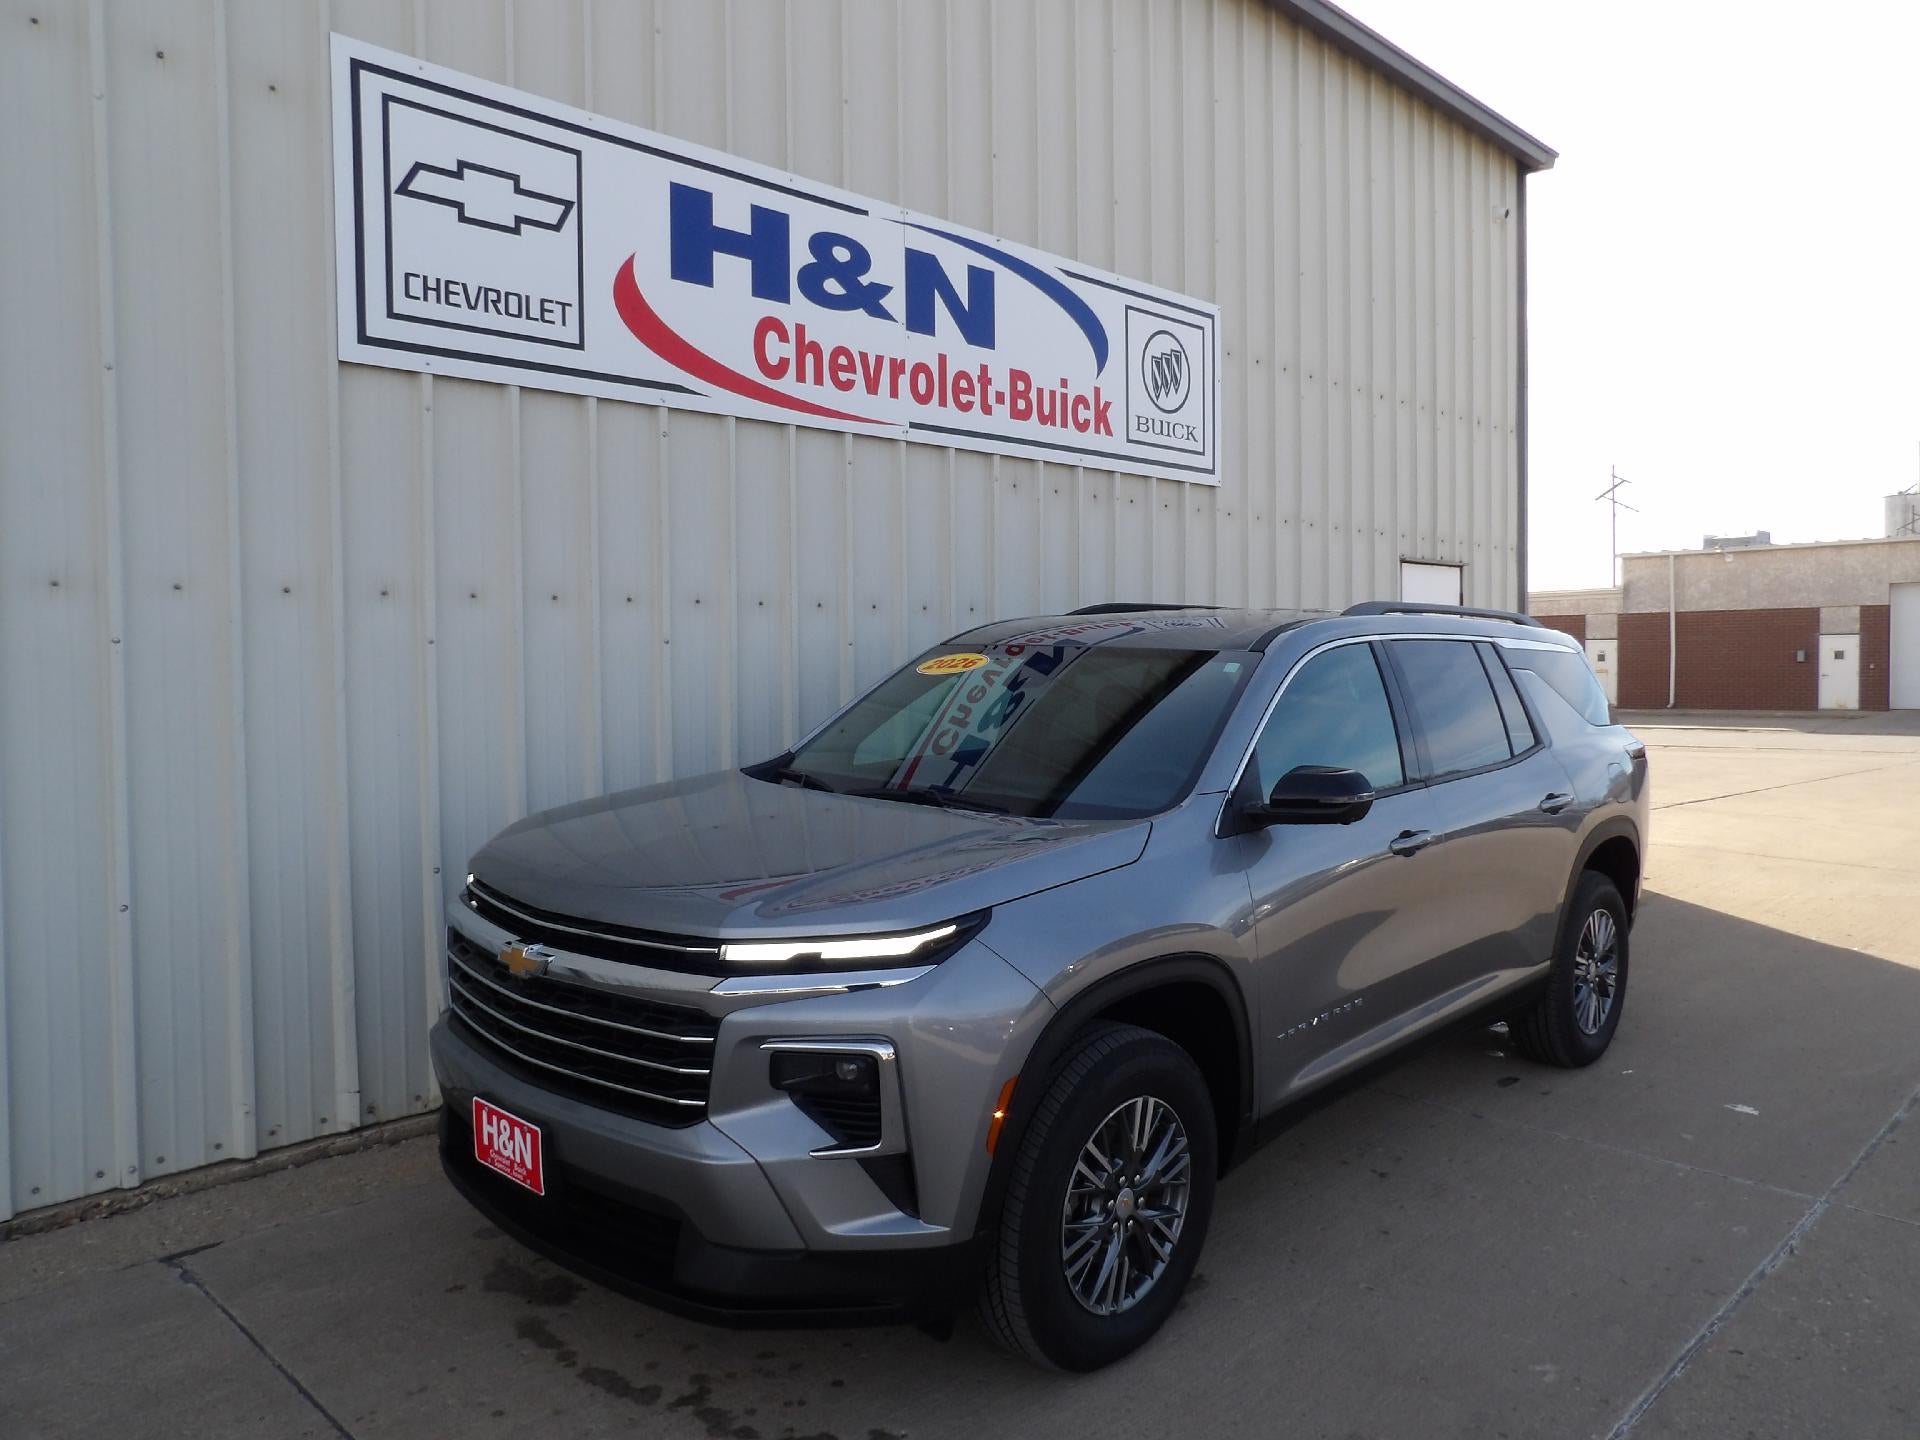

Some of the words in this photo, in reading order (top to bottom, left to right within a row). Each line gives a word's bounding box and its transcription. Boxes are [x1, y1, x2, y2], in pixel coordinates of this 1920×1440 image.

[670, 181, 995, 350] H&N
[403, 272, 573, 327] CHEVROLET
[753, 316, 1114, 437] Chevrolet-Buick
[1135, 415, 1199, 442] BUICK
[922, 658, 984, 669] 2026
[482, 1109, 532, 1170] H&N
